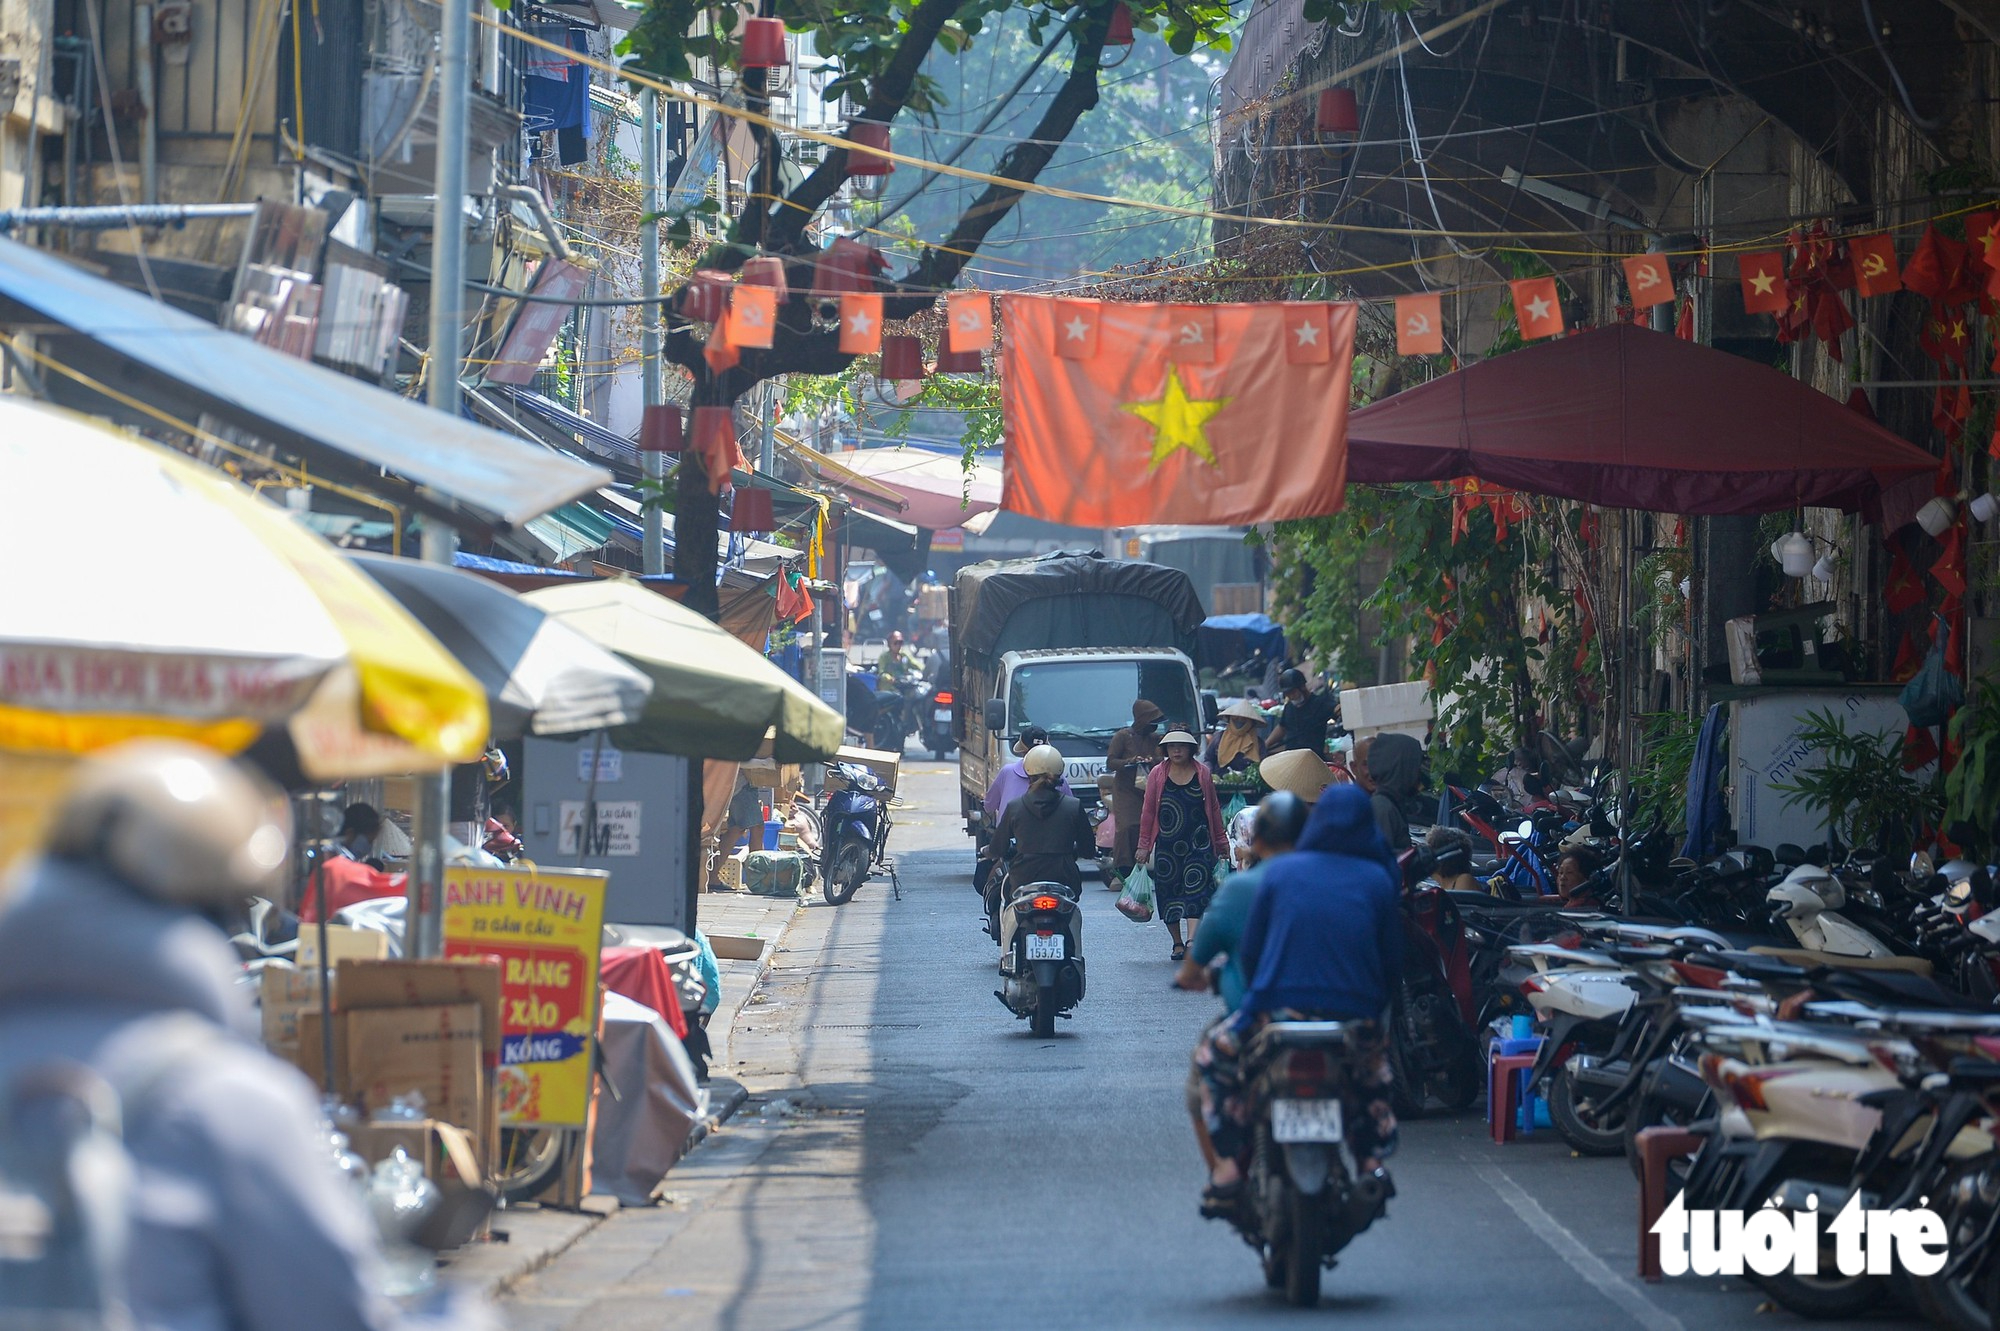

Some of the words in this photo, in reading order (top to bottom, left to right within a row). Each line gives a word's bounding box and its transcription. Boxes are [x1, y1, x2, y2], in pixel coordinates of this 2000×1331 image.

[1065, 762, 1100, 778] ONG
[514, 880, 588, 922] VINH
[1030, 947, 1062, 958] 153.75
[505, 957, 572, 988] RANG
[508, 994, 559, 1028] XÀO
